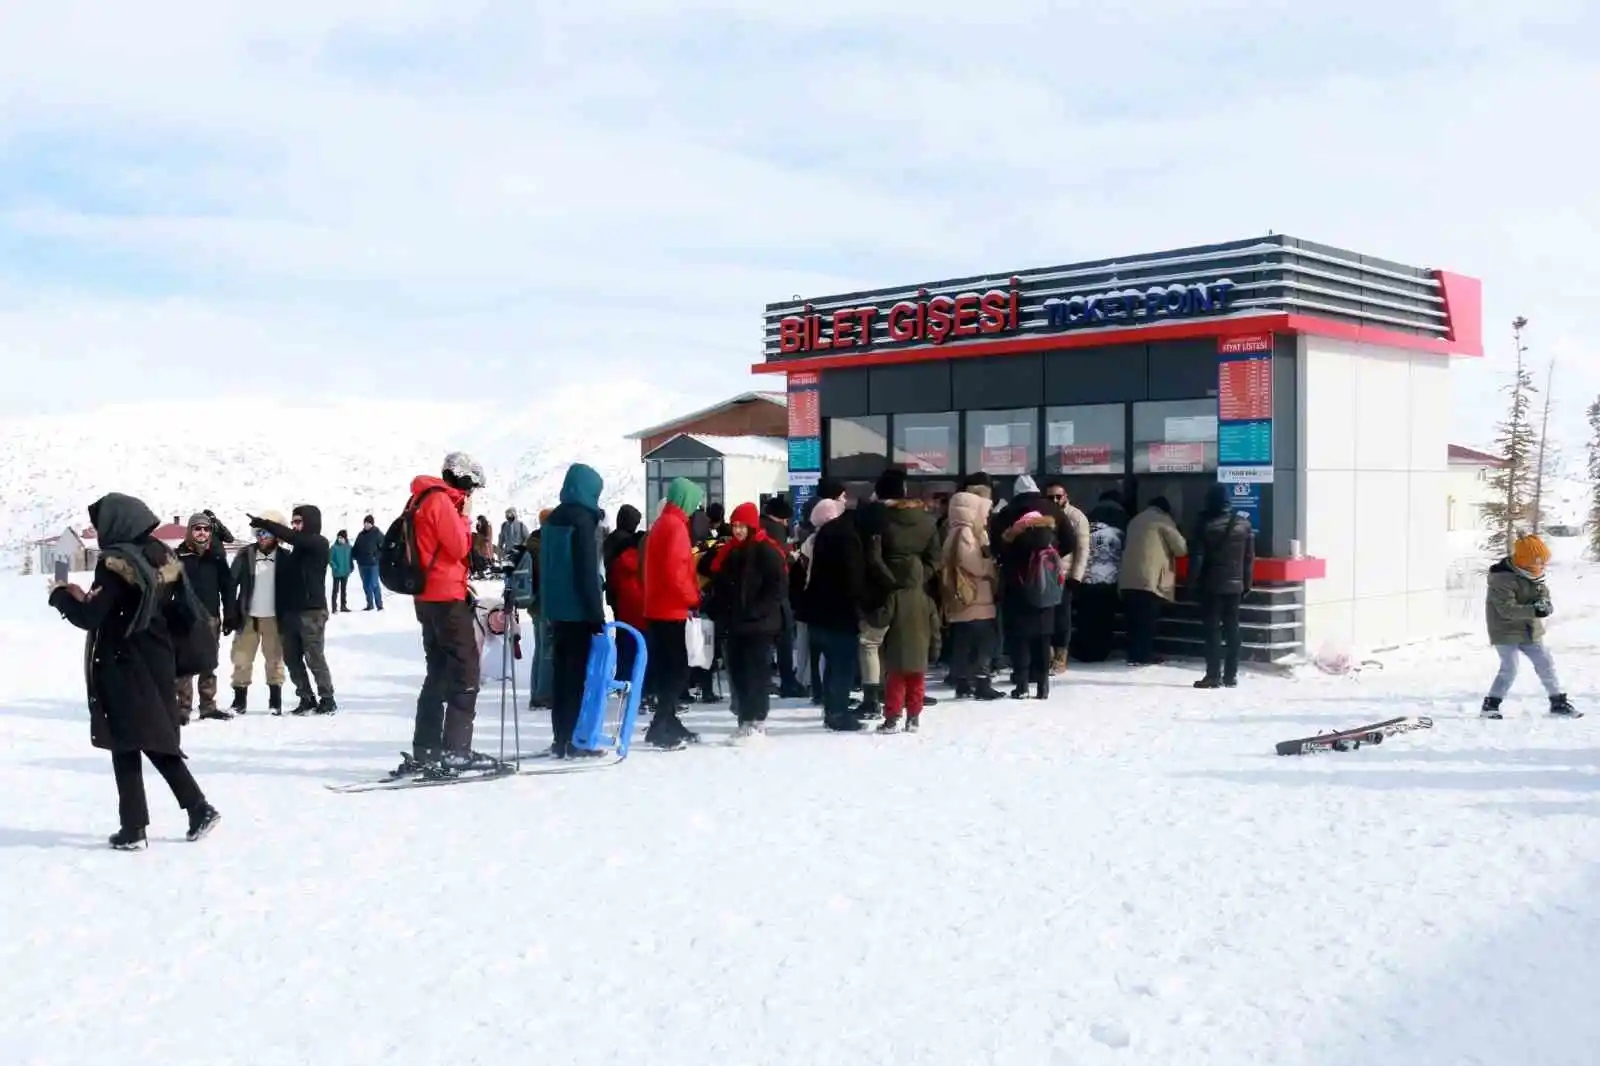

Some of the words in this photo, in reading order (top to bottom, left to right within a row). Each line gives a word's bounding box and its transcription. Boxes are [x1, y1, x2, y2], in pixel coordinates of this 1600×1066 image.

[780, 302, 878, 353] BİLET
[888, 275, 1020, 345] GİŞESİ
[1044, 293, 1142, 326] TICKET
[1146, 280, 1235, 317] POINT
